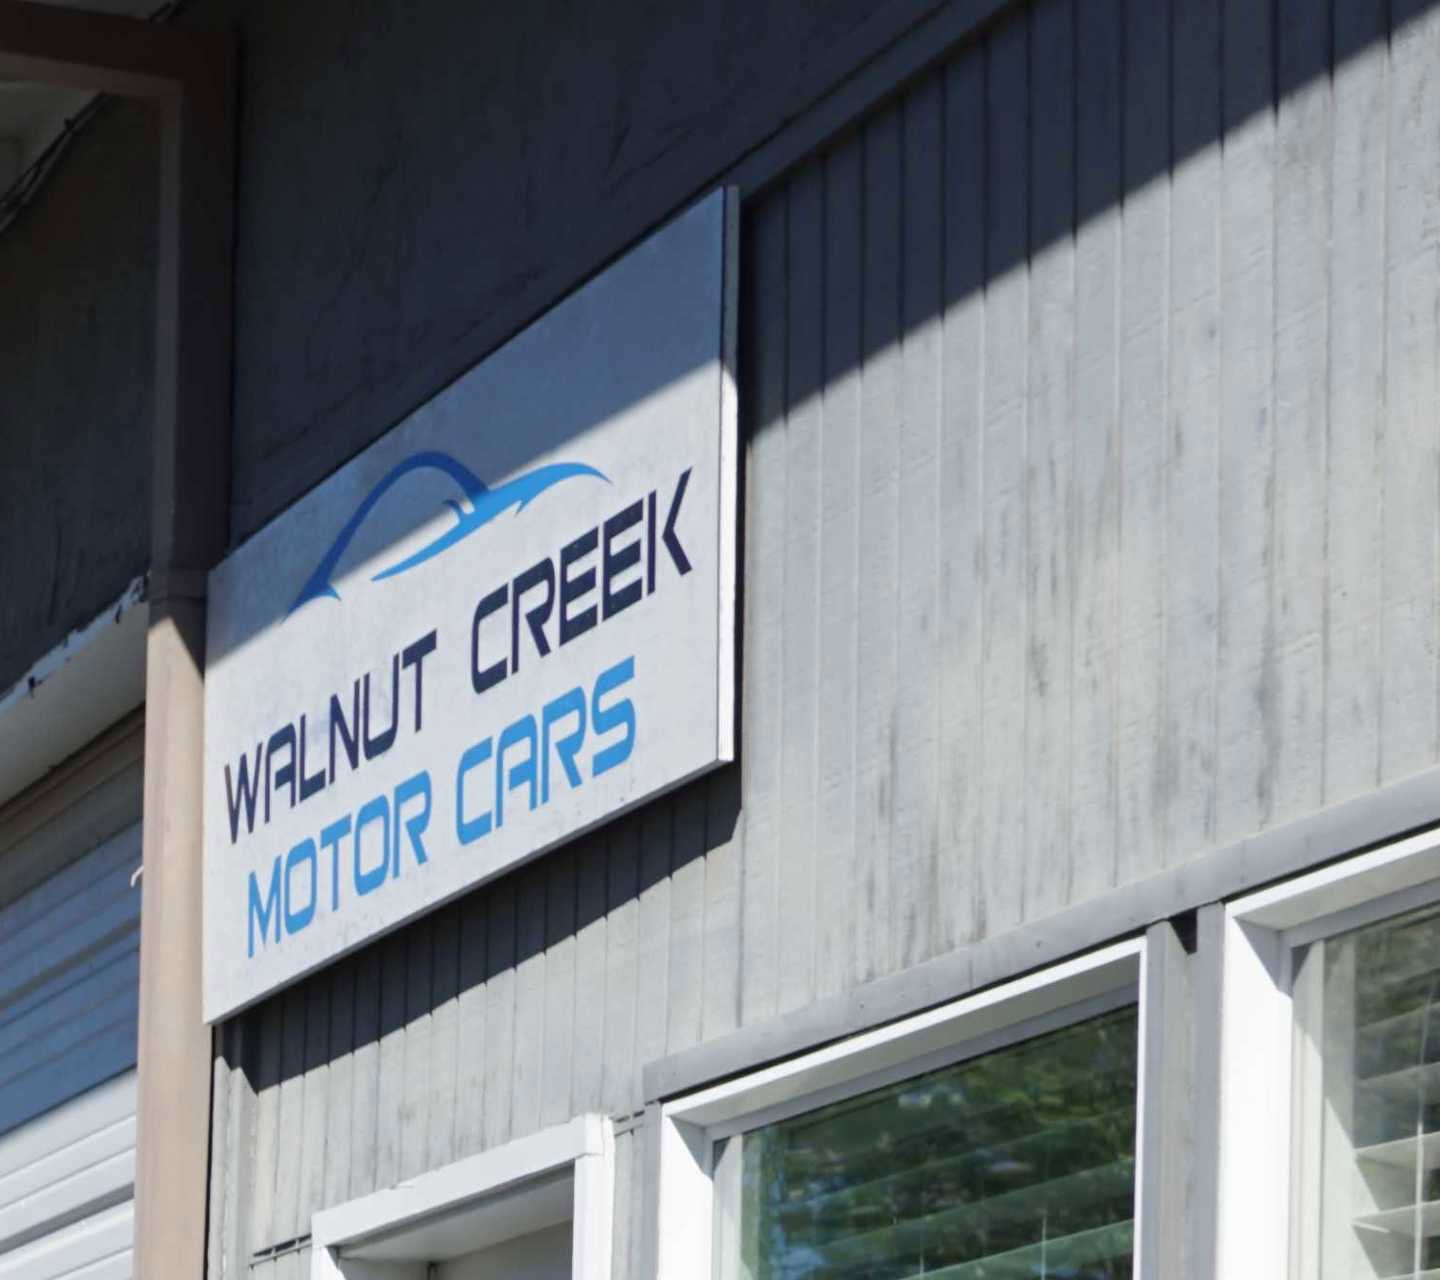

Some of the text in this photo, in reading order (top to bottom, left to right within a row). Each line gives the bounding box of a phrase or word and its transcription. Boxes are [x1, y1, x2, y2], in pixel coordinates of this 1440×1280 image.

[225, 467, 693, 845] WALNUT CREEK
[248, 655, 636, 958] MOTOR CARS
